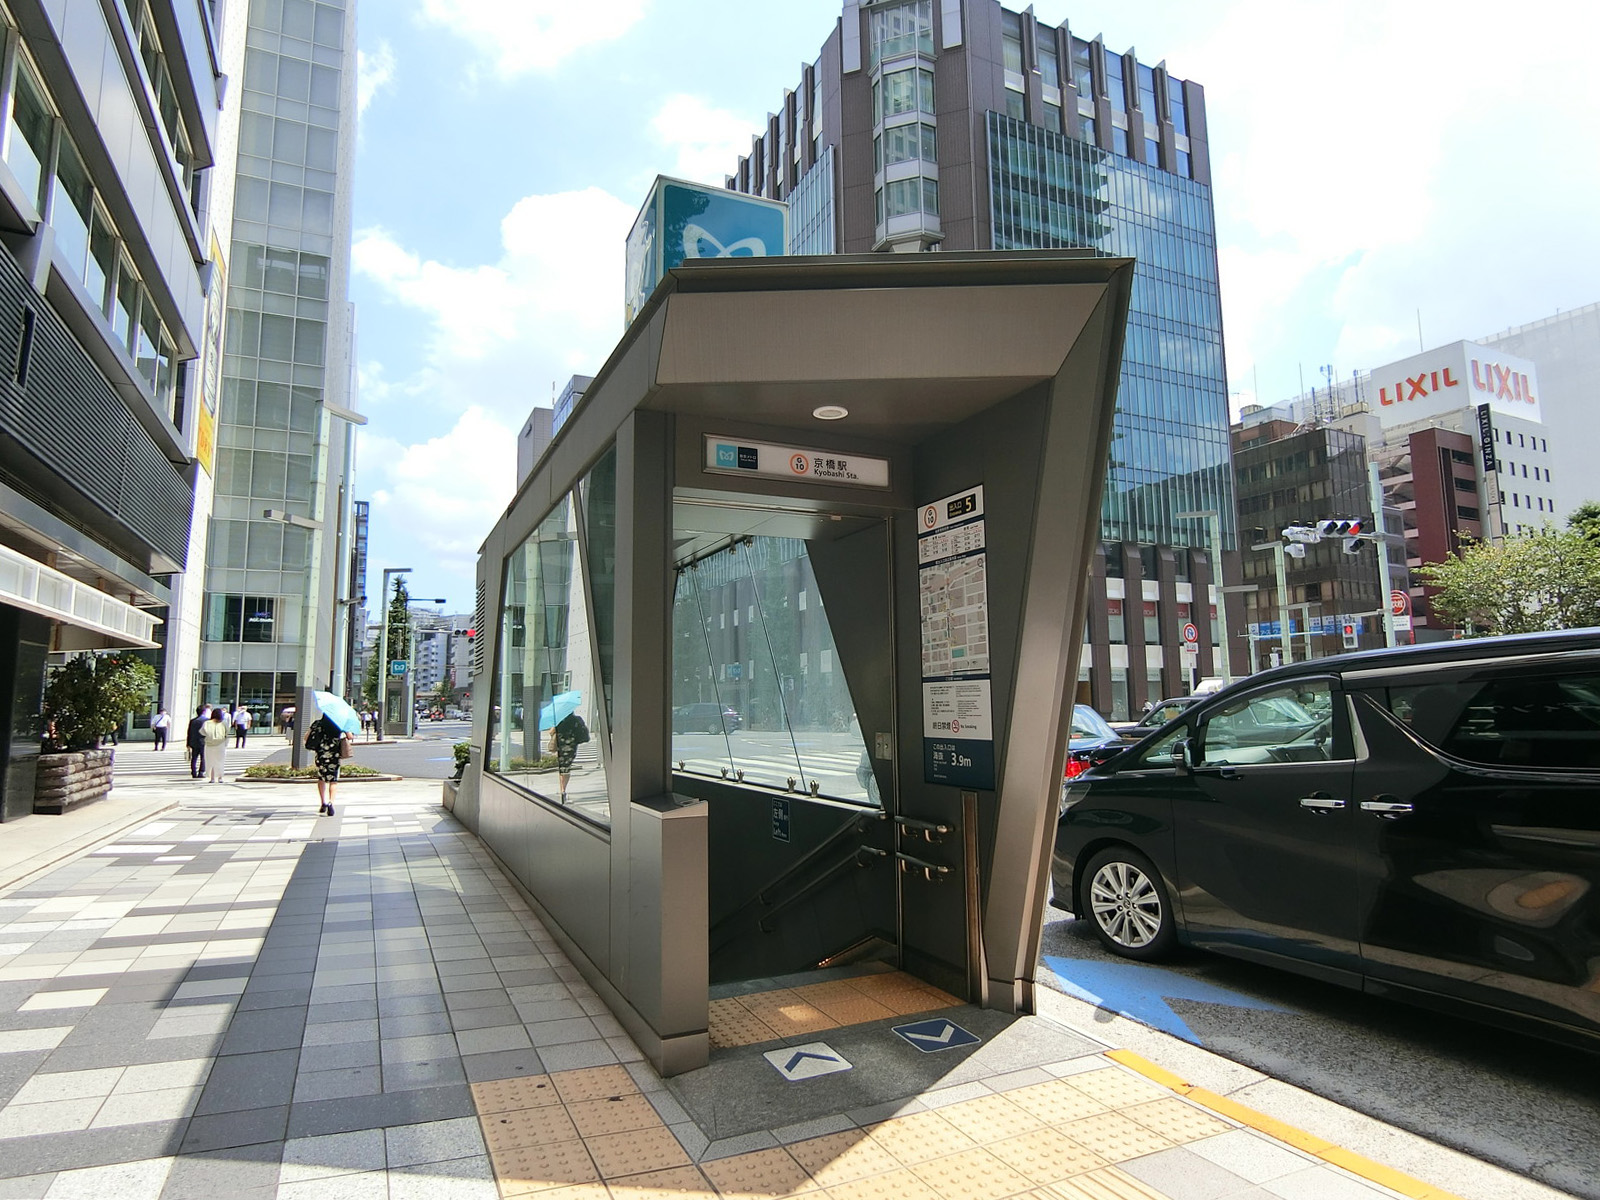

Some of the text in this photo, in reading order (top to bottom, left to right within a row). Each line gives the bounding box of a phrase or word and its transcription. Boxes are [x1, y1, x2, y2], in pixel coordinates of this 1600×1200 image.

[1379, 367, 1458, 406] LIXIL
[1471, 359, 1535, 404] LIXIL
[795, 463, 805, 471] 10
[813, 457, 848, 471] 京橋駅
[814, 468, 859, 480] Kyobashi Sta.
[965, 497, 972, 512] 5
[951, 752, 972, 767] 3.9m
